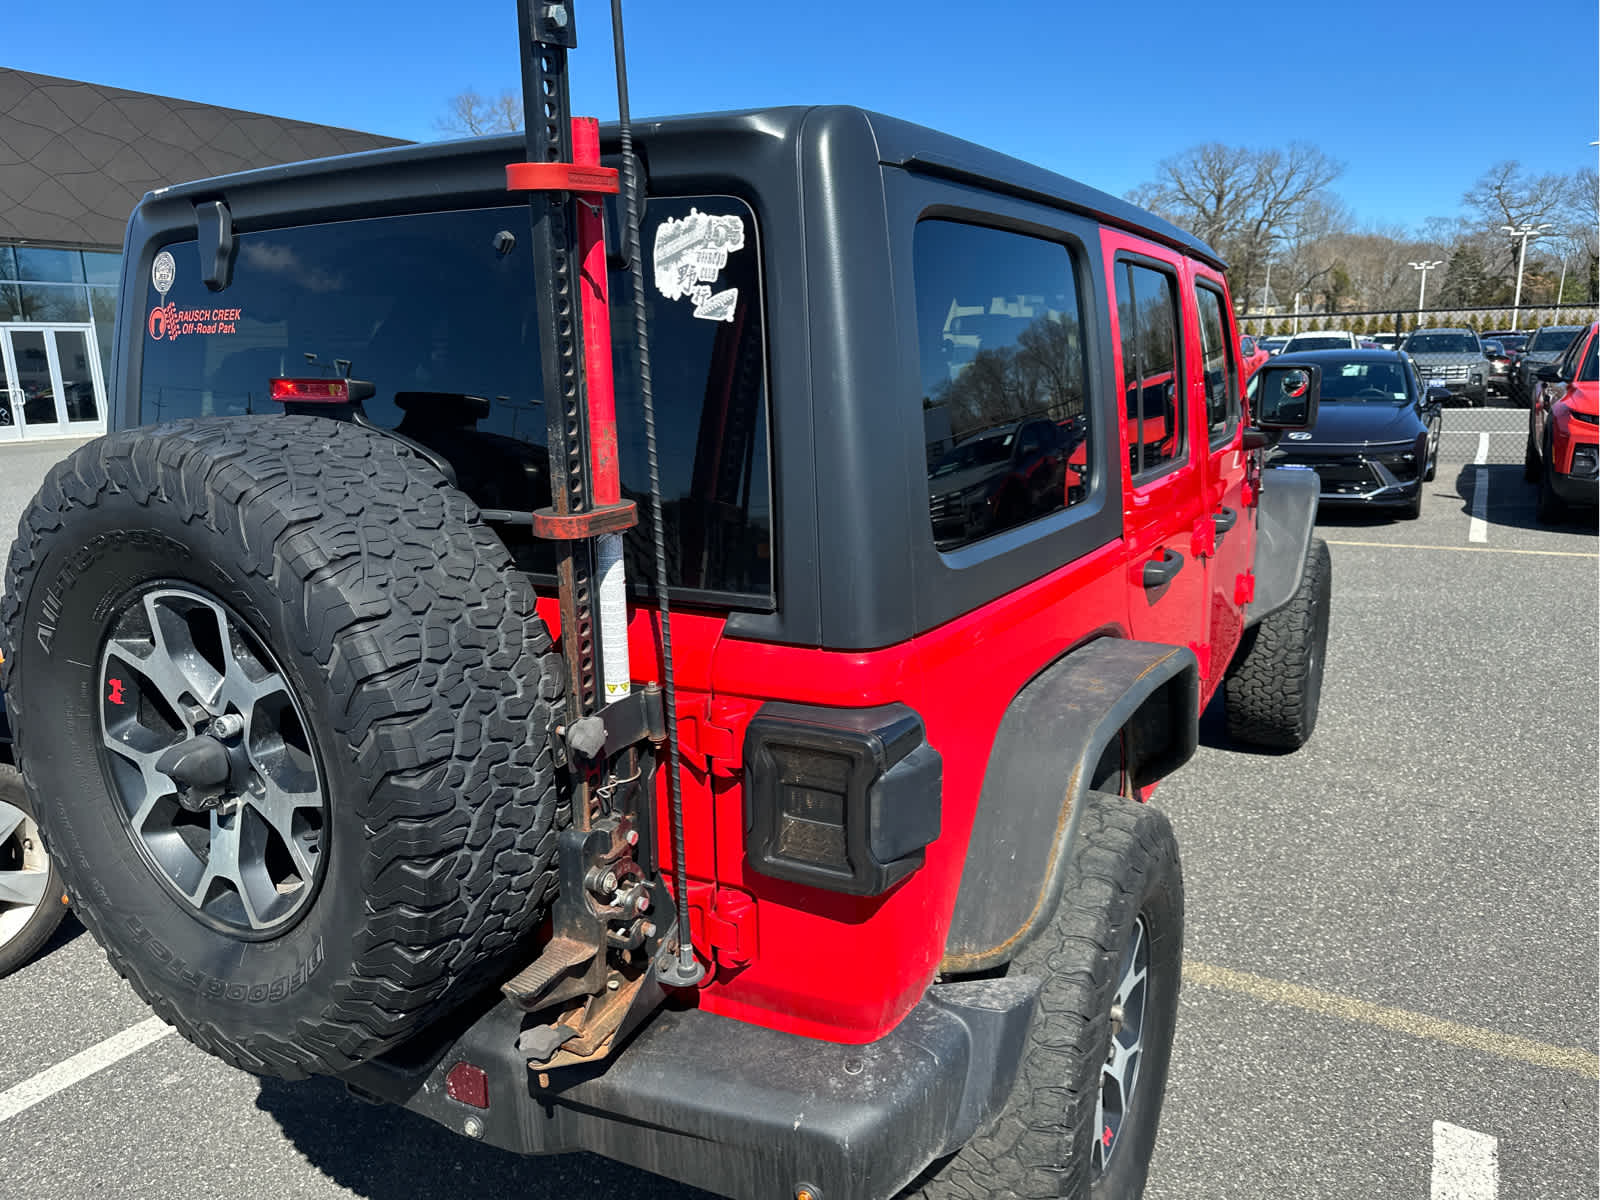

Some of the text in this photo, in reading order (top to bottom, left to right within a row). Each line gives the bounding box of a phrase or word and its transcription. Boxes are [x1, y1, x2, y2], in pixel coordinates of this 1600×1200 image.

[178, 308, 241, 322] RAUSCH CREEK
[182, 322, 236, 334] Off-Road Park
